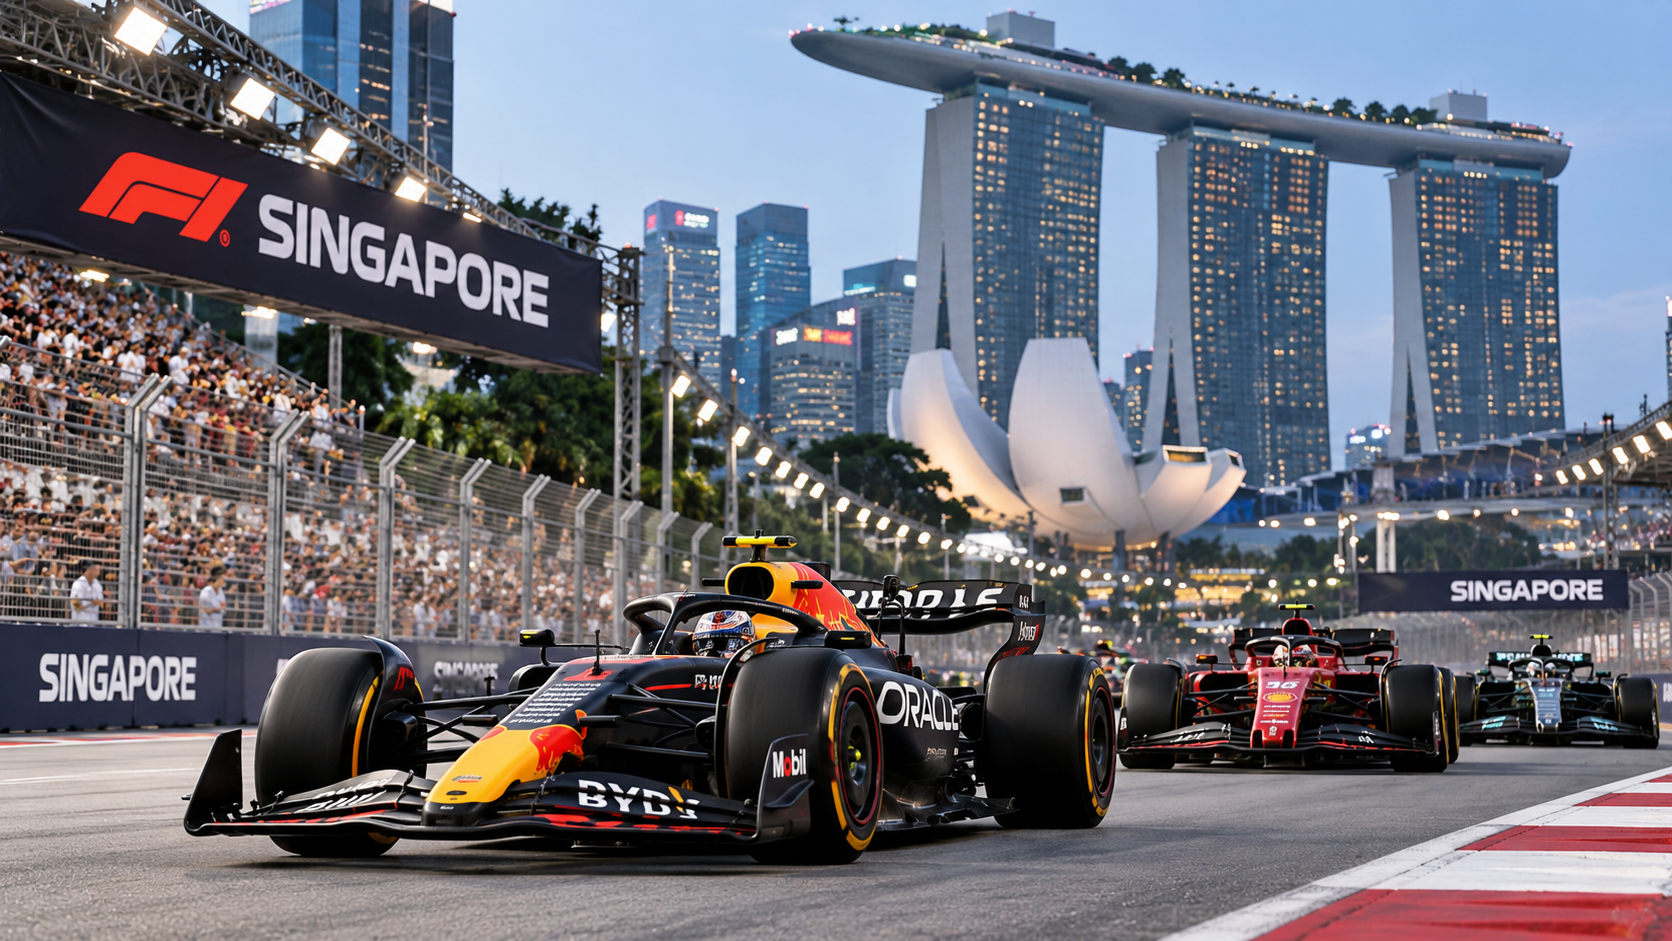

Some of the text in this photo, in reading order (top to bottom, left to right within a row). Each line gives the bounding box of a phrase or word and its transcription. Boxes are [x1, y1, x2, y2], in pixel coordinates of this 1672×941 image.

[259, 193, 549, 328] SINGAPORE
[1450, 578, 1604, 602] SINGAPORE
[38, 653, 197, 702] SINGAPORE
[876, 681, 959, 731] ORACLE
[772, 748, 807, 778] Mobil
